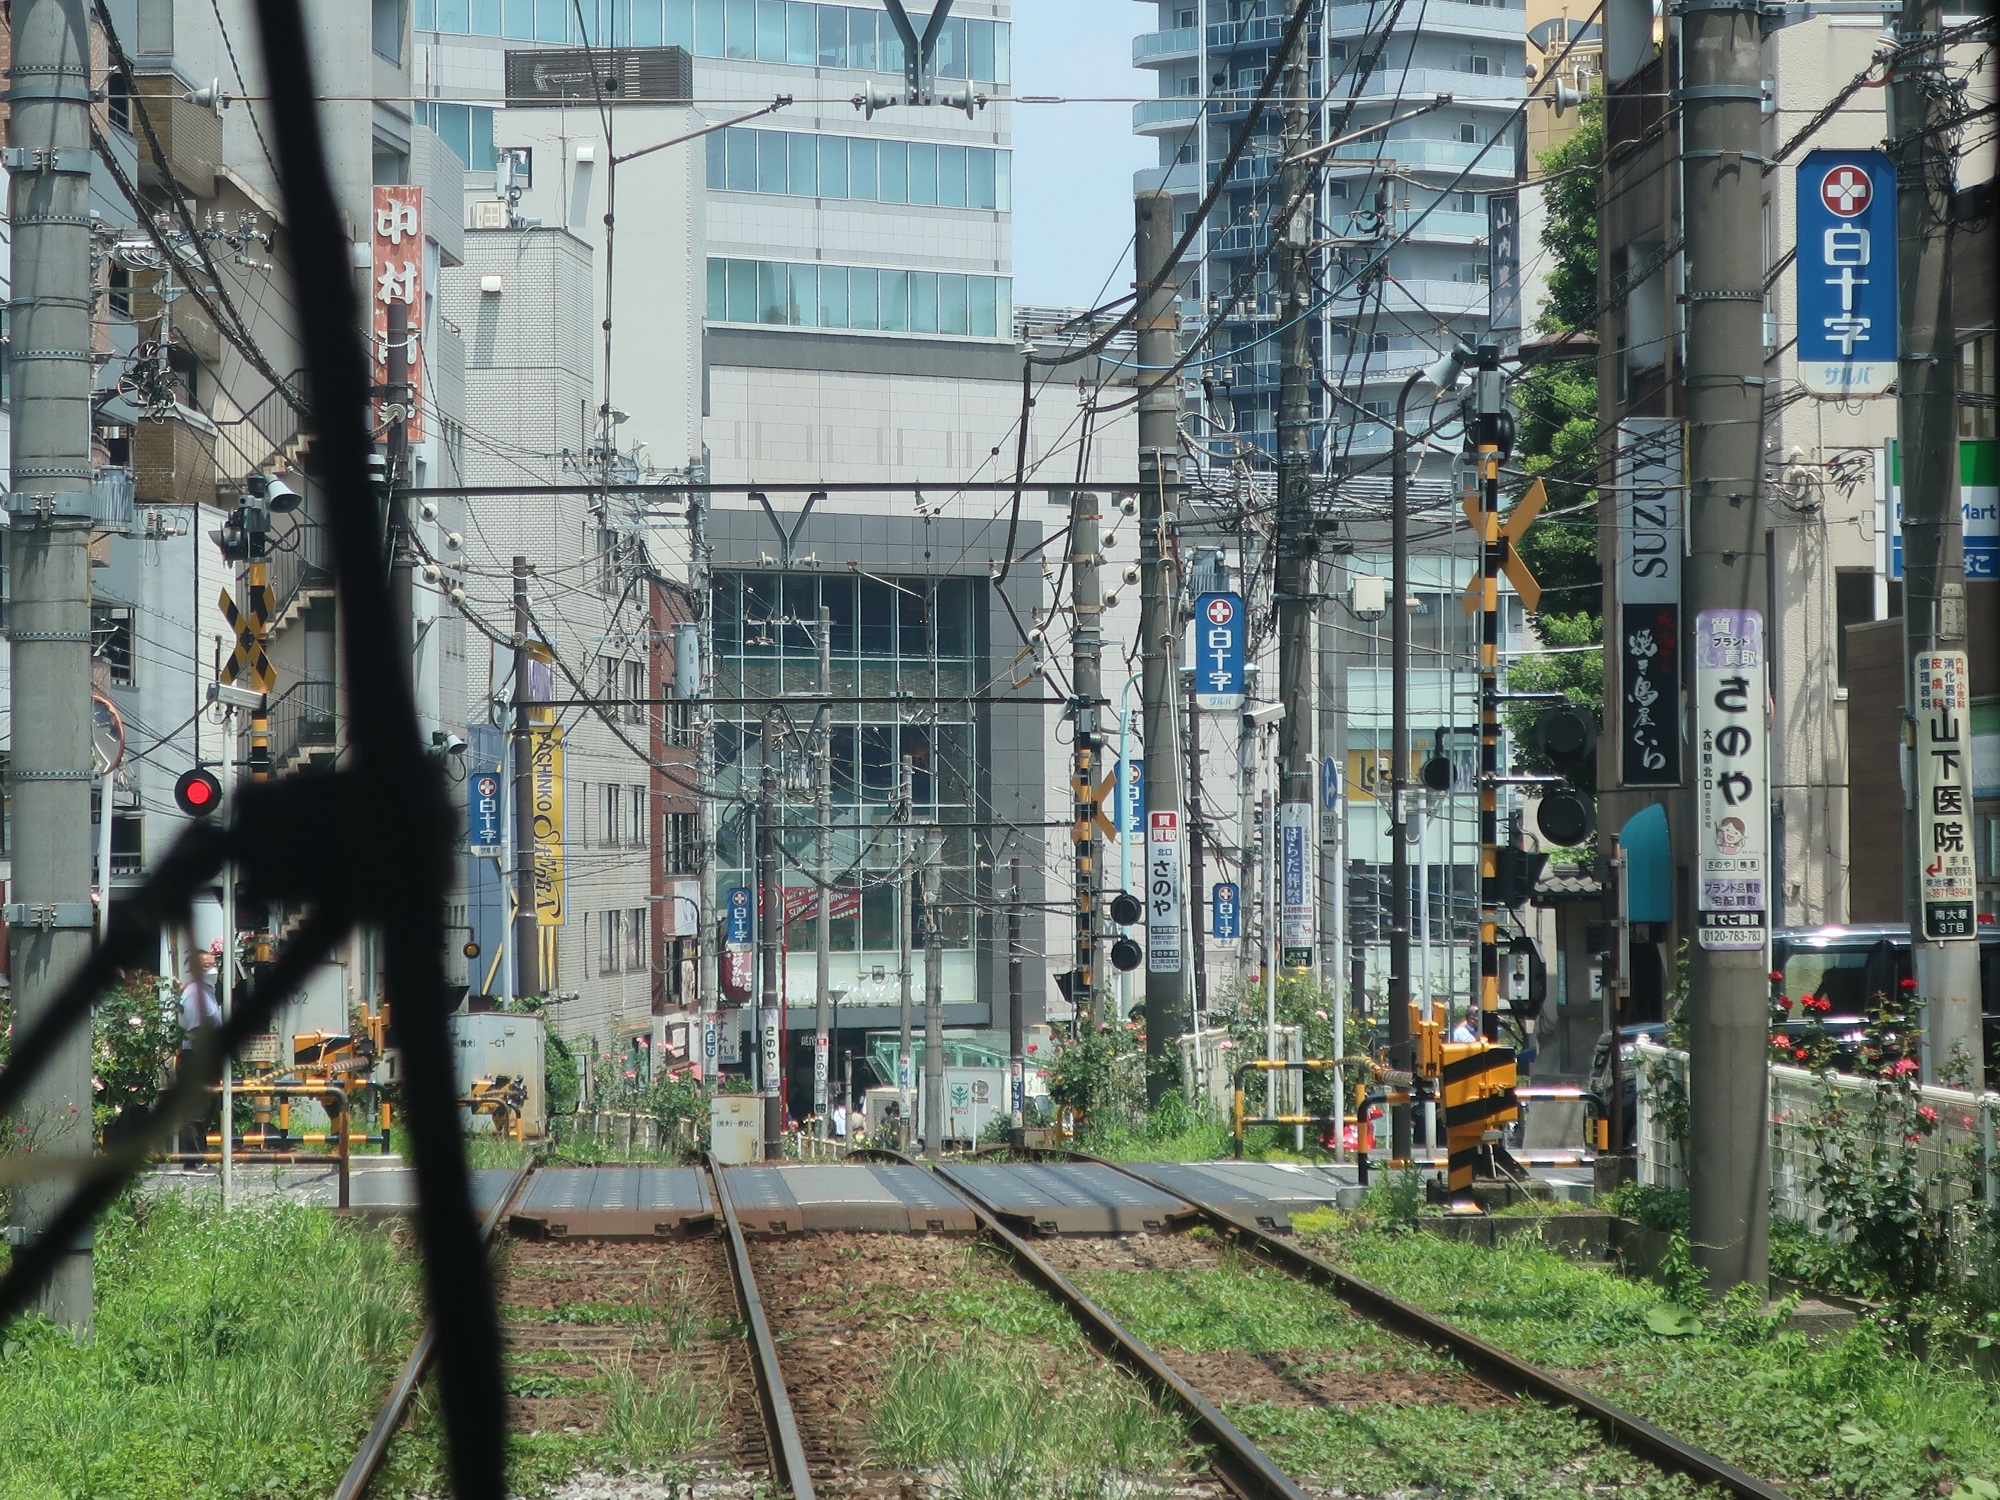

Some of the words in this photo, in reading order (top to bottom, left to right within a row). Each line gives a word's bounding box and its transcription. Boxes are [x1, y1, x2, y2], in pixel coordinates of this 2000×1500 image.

[1823, 222, 1872, 355] 白十字
[1823, 366, 1874, 385] サルバ
[1712, 617, 1732, 635] 質
[1713, 637, 1750, 647] ブランド
[1208, 627, 1232, 692] 白十字
[1724, 650, 1756, 666] 買取
[1931, 658, 1944, 710] 皮膚科
[1944, 658, 1956, 710] 消化器科
[1714, 675, 1753, 807] さのや
[536, 731, 554, 812] PACHINKO
[1930, 708, 1965, 853] 山下医院
[479, 798, 497, 843] 白十字
[1153, 829, 1177, 841] 買取
[1157, 848, 1173, 856] 北口
[1285, 827, 1301, 904] はらだ葬祭
[1707, 860, 1732, 870] さのや
[1152, 860, 1172, 917] さのや
[1705, 883, 1761, 895] ブランド品買取
[1711, 896, 1757, 907] 宅配買取
[733, 906, 748, 942] 白十字
[1219, 901, 1233, 937] 白十字
[1935, 909, 1968, 920] 南大塚
[1939, 923, 1965, 934] 3丁目
[1704, 930, 1761, 942] 0120-783-783
[765, 1026, 776, 1060] さのや
[816, 1053, 825, 1078] さのや
